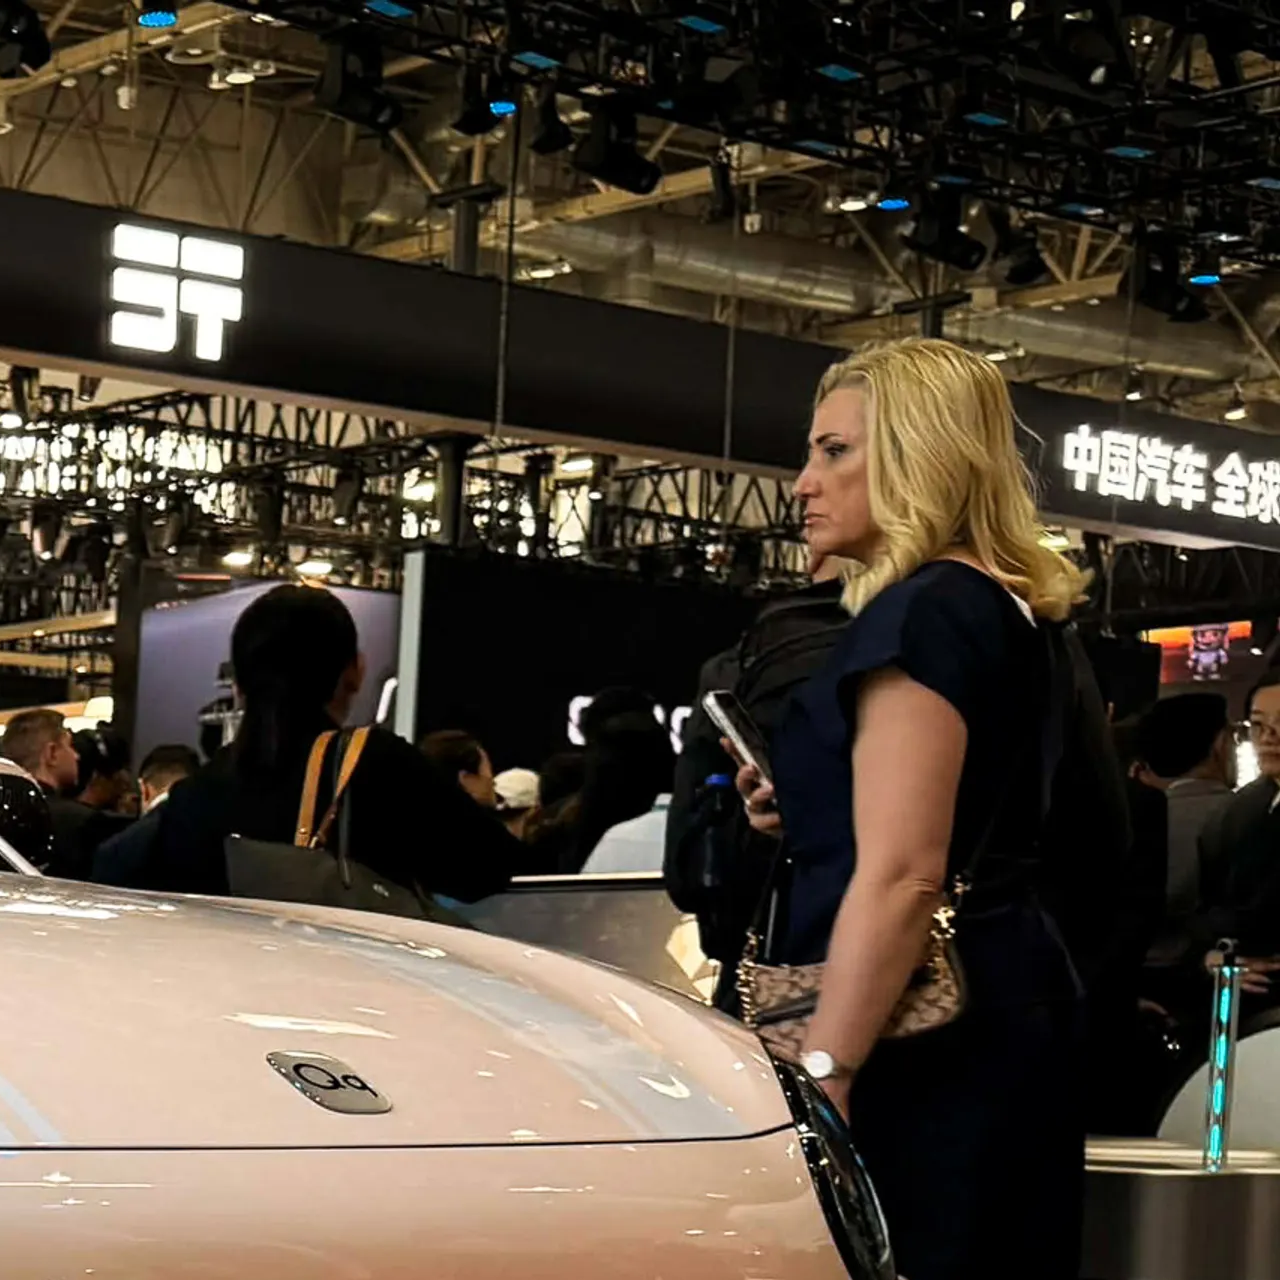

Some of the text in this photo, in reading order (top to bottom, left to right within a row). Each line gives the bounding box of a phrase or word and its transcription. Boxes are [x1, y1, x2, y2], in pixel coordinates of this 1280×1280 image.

[1062, 423, 1280, 525] 中国汽车 全球
